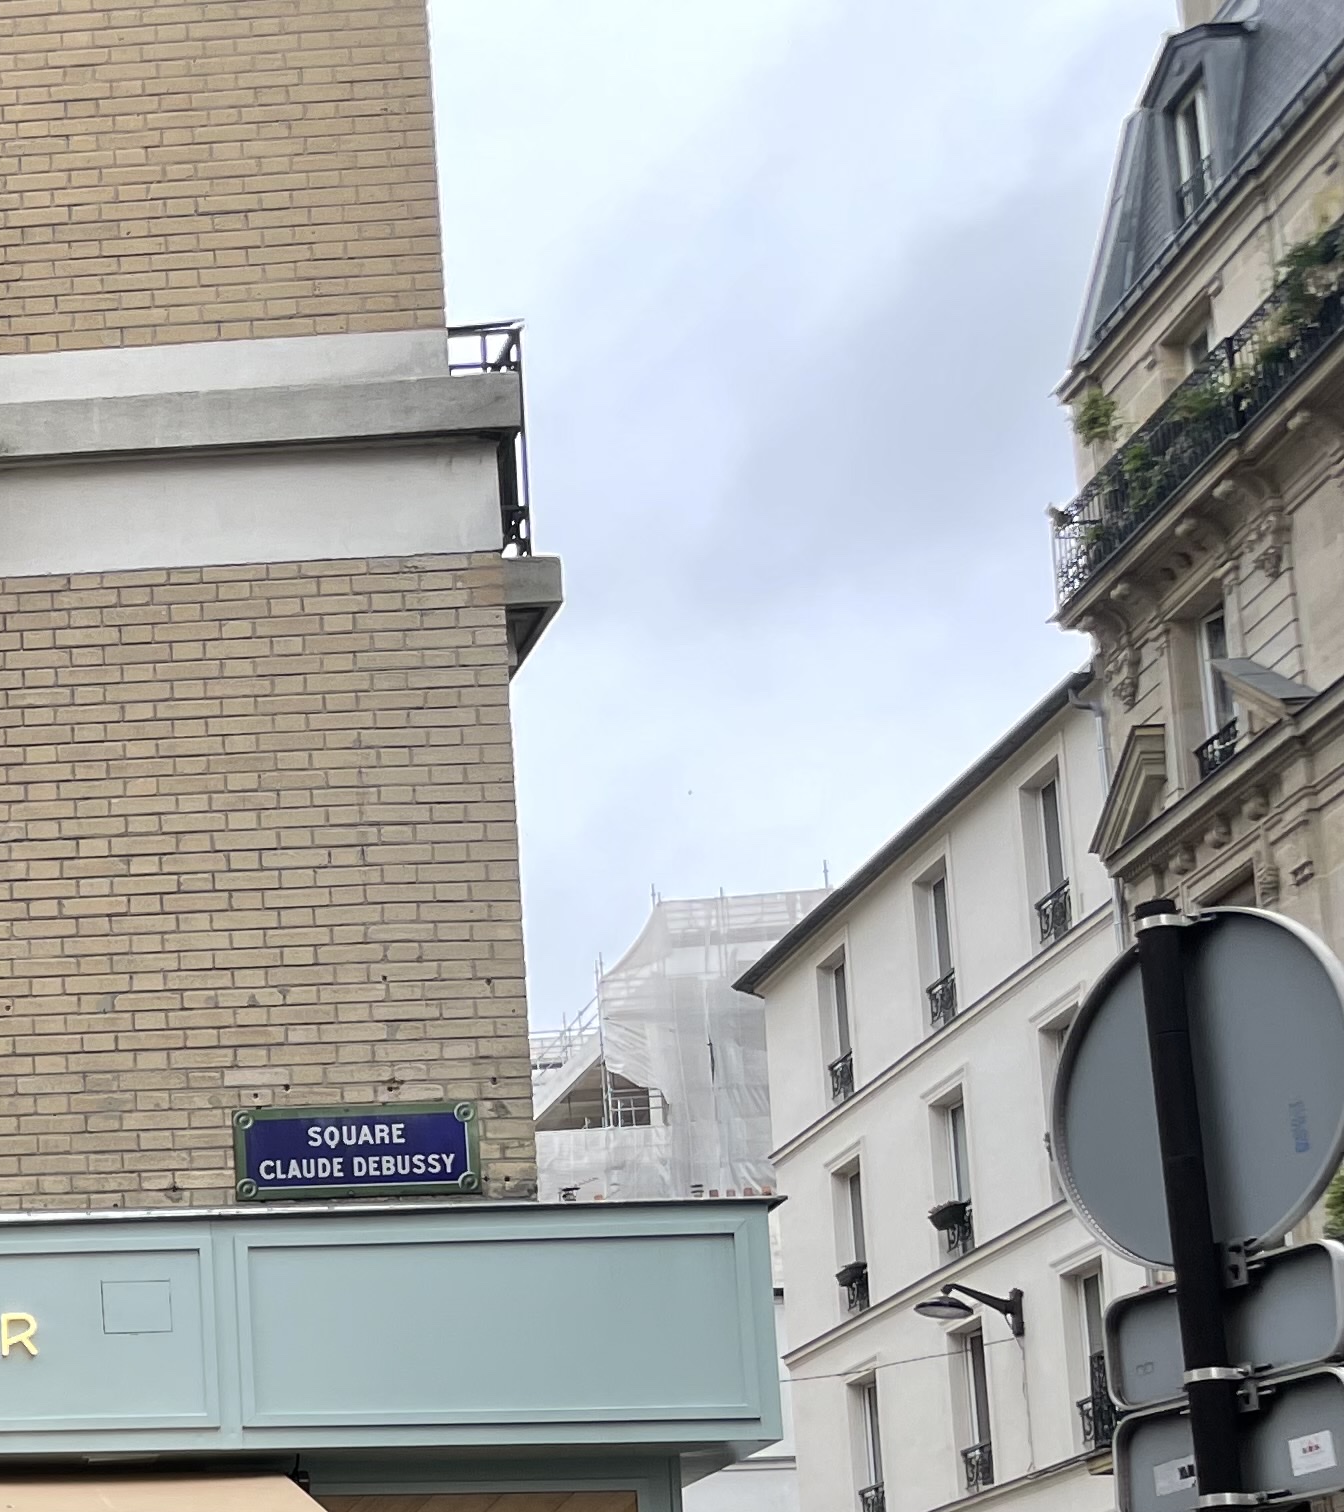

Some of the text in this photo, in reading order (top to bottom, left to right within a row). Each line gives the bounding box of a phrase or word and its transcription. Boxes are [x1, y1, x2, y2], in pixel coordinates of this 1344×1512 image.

[307, 1123, 406, 1149] SQUARE
[259, 1153, 456, 1180] CLAUDE DEBUSSY
